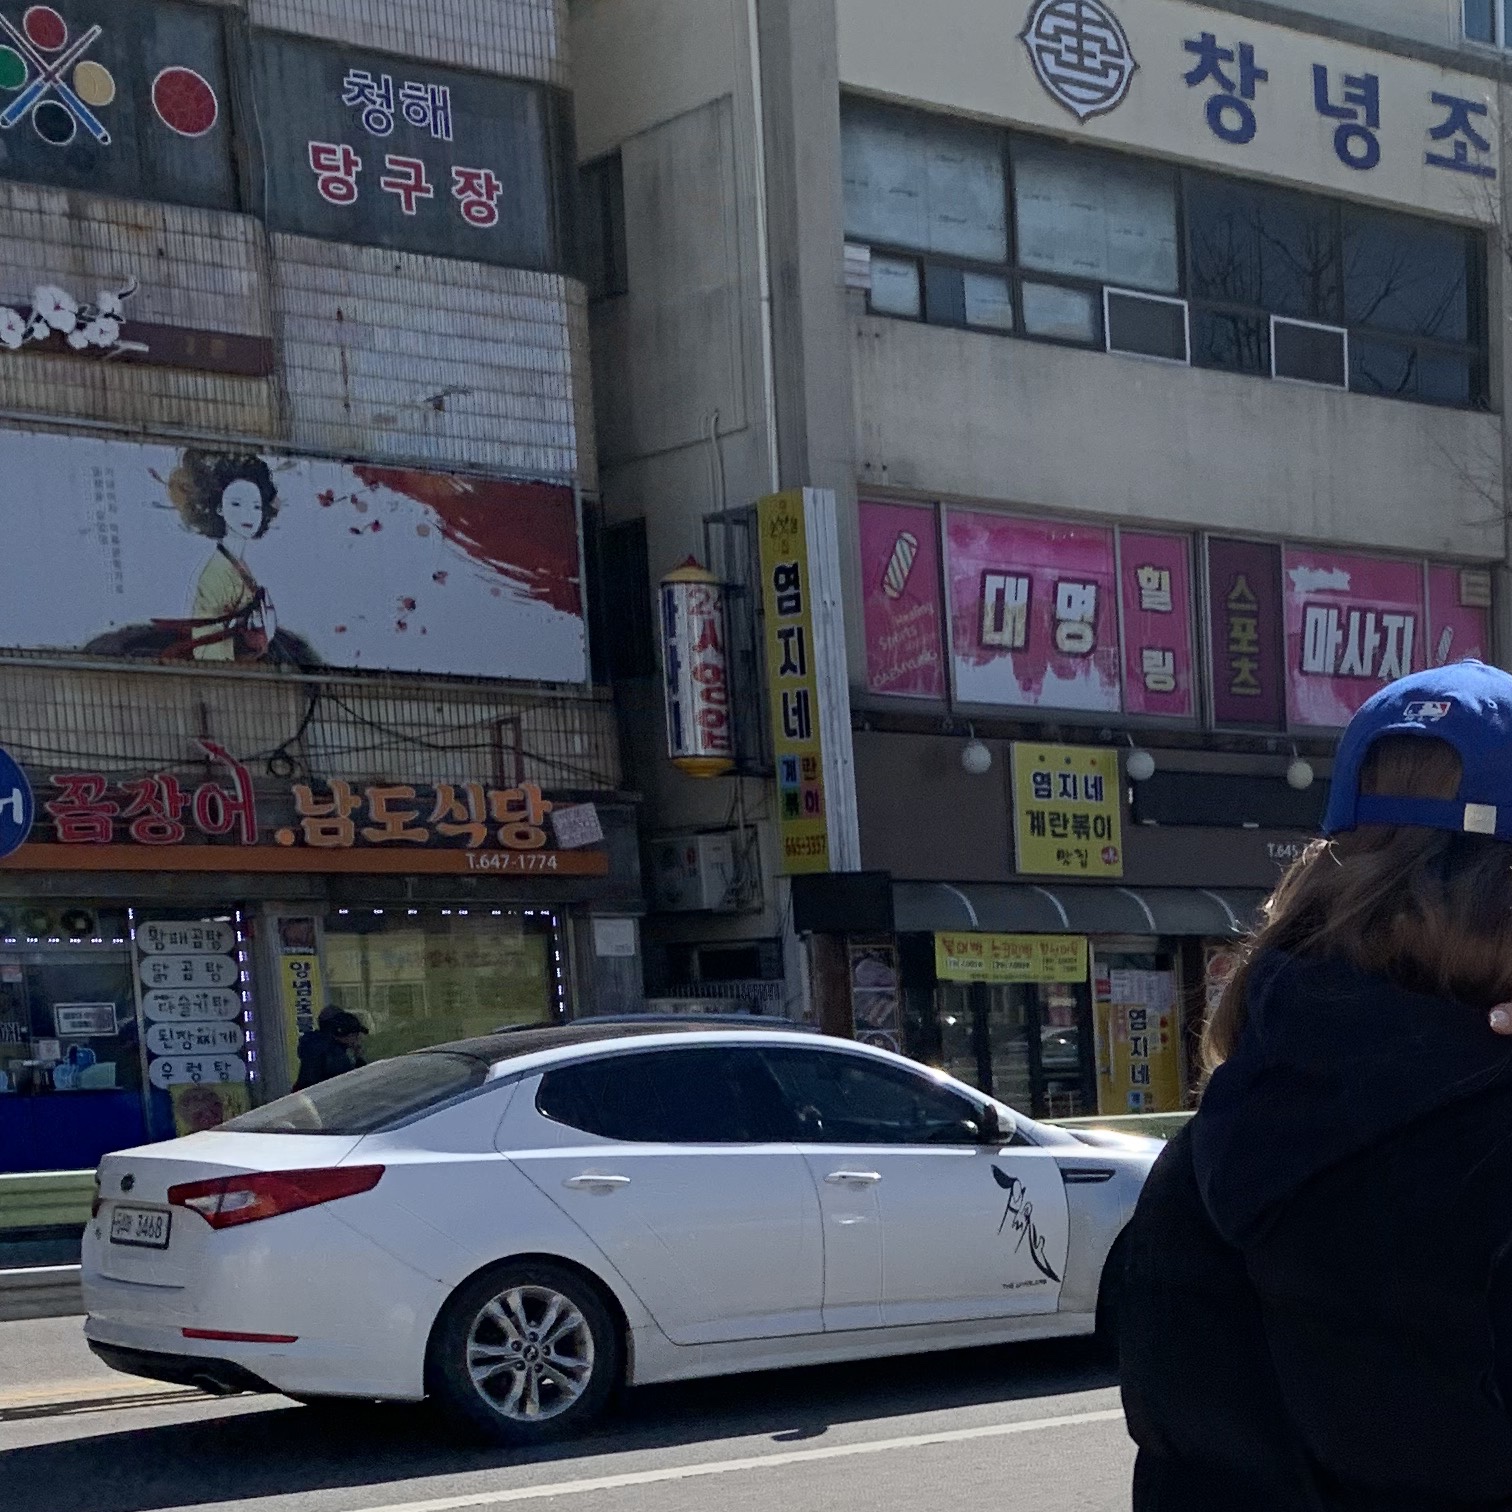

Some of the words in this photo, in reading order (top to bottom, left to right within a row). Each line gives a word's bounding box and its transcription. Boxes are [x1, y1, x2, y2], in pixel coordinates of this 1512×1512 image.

[342, 68, 454, 141] 청해
[308, 141, 502, 227] 당구장
[772, 561, 816, 741] 염지네
[981, 570, 1101, 656] 대명
[1136, 565, 1176, 694] 힐링
[1226, 573, 1262, 695] 스포츠
[1302, 605, 1415, 680] 마사지
[1025, 809, 1112, 841] 계란볶이
[1032, 771, 1104, 803] 염지네
[466, 852, 558, 871] T.647-1774
[1128, 1008, 1150, 1085] 염지네
